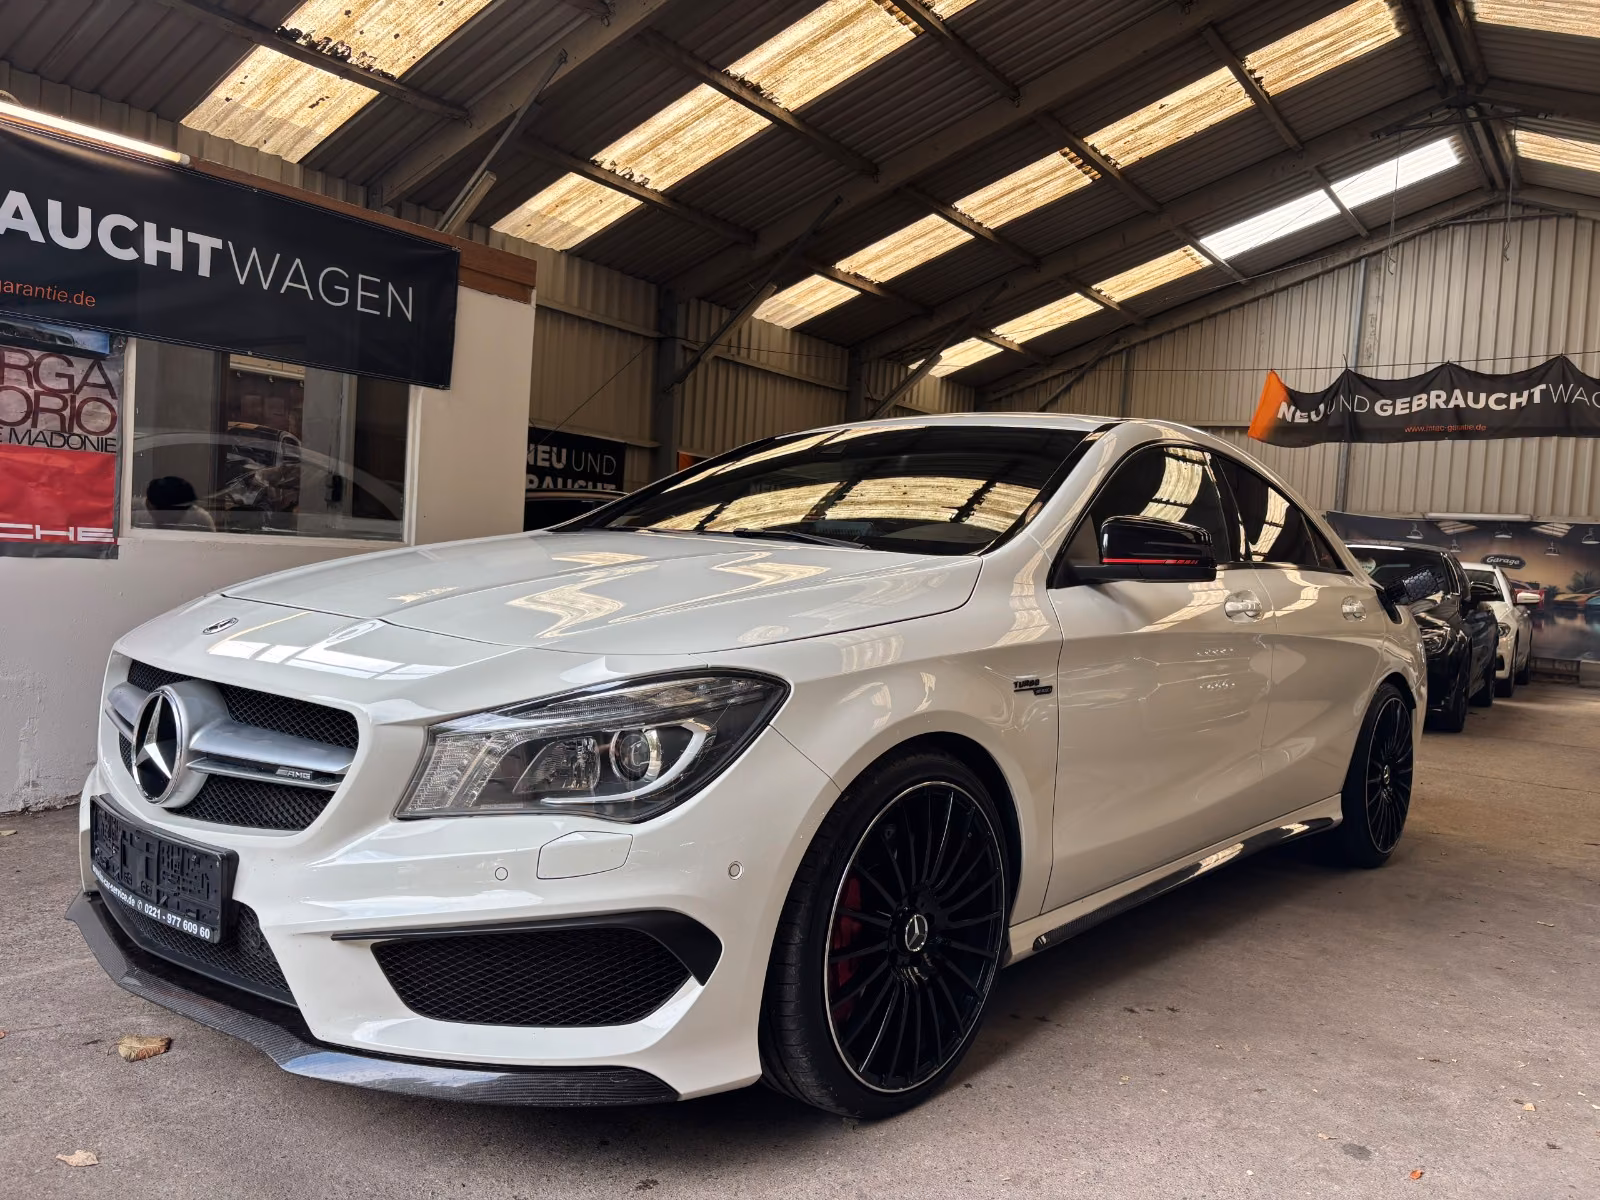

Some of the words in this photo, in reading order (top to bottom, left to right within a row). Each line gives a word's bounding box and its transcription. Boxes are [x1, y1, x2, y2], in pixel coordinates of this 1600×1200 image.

[0, 279, 96, 307] arantie.de
[9, 428, 117, 453] MADONIE
[572, 449, 617, 476] UND
[1486, 556, 1520, 566] Garage
[144, 903, 161, 920] 0221
[167, 913, 182, 928] 977
[182, 920, 198, 935] 609
[199, 926, 211, 940] 60
